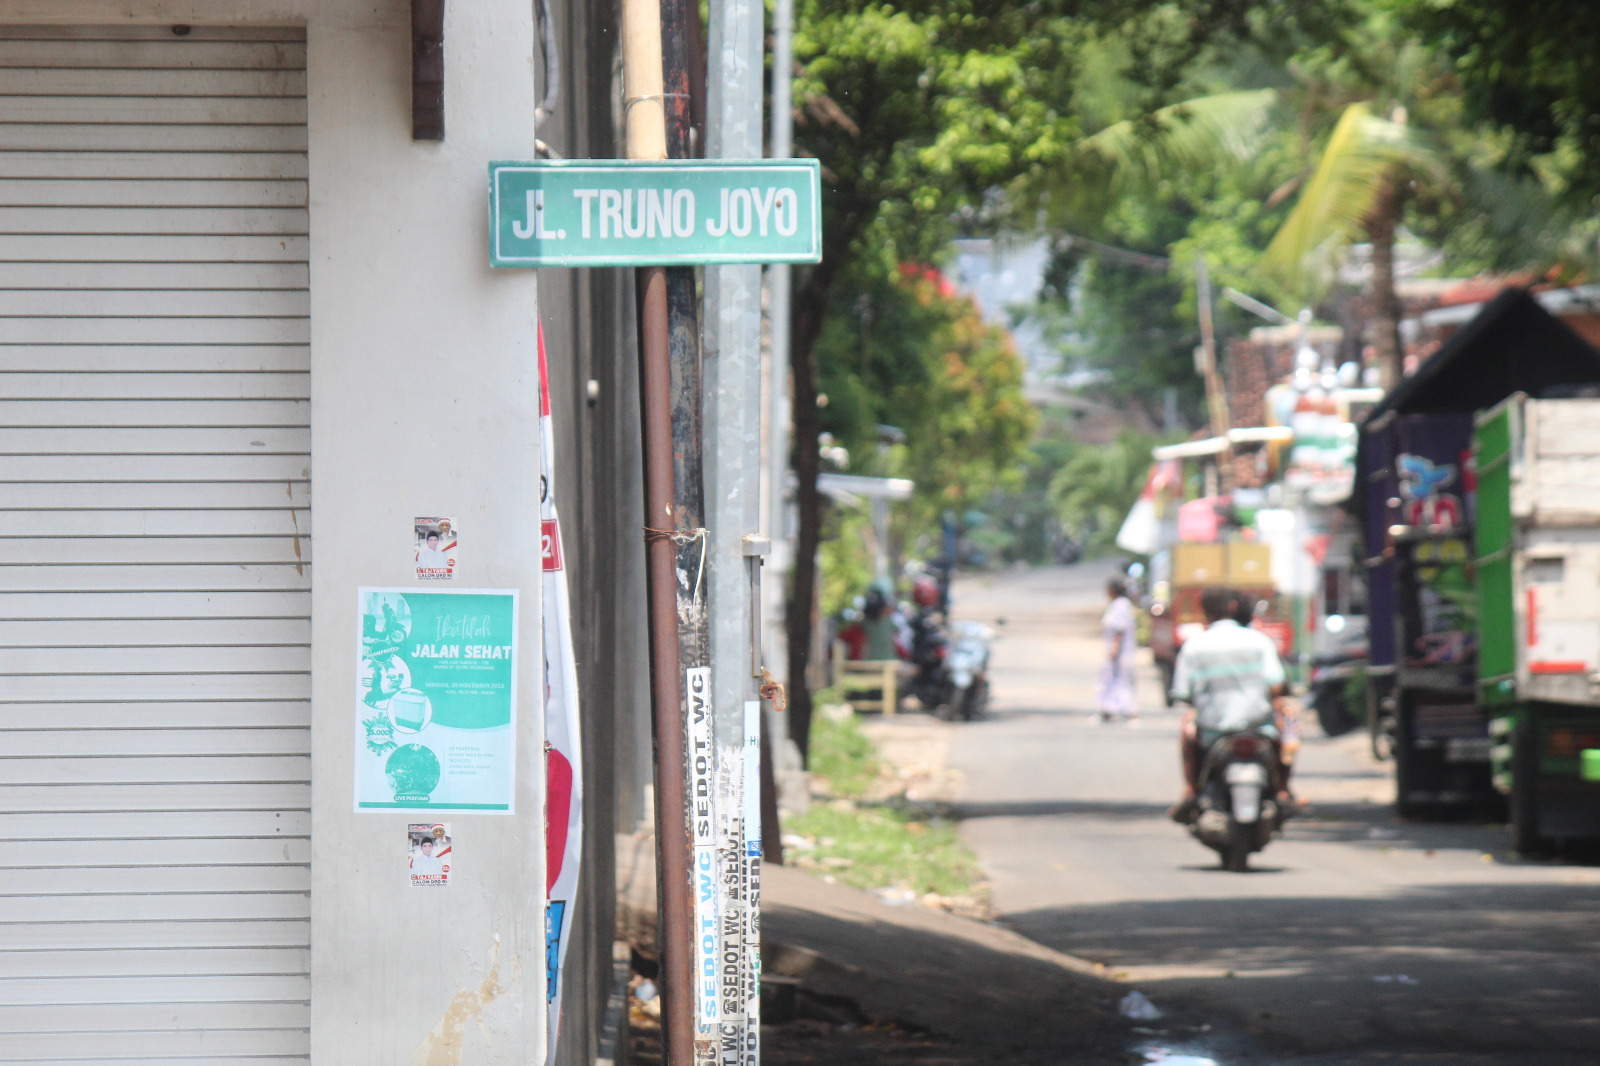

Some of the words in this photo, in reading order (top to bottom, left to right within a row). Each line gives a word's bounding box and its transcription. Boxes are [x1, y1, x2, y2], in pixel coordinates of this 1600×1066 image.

[512, 188, 567, 240] JL.
[573, 188, 695, 239] TRUNO
[706, 186, 798, 237] JOYO
[411, 643, 460, 659] JALAN
[464, 645, 512, 660] SEHAT
[691, 674, 705, 724] WC
[694, 736, 709, 837] SEDOT
[699, 851, 712, 903] WC
[724, 909, 739, 936] WC
[702, 915, 716, 1018] SEDOT
[723, 940, 739, 998] SEDOT
[722, 1025, 737, 1052] WC
